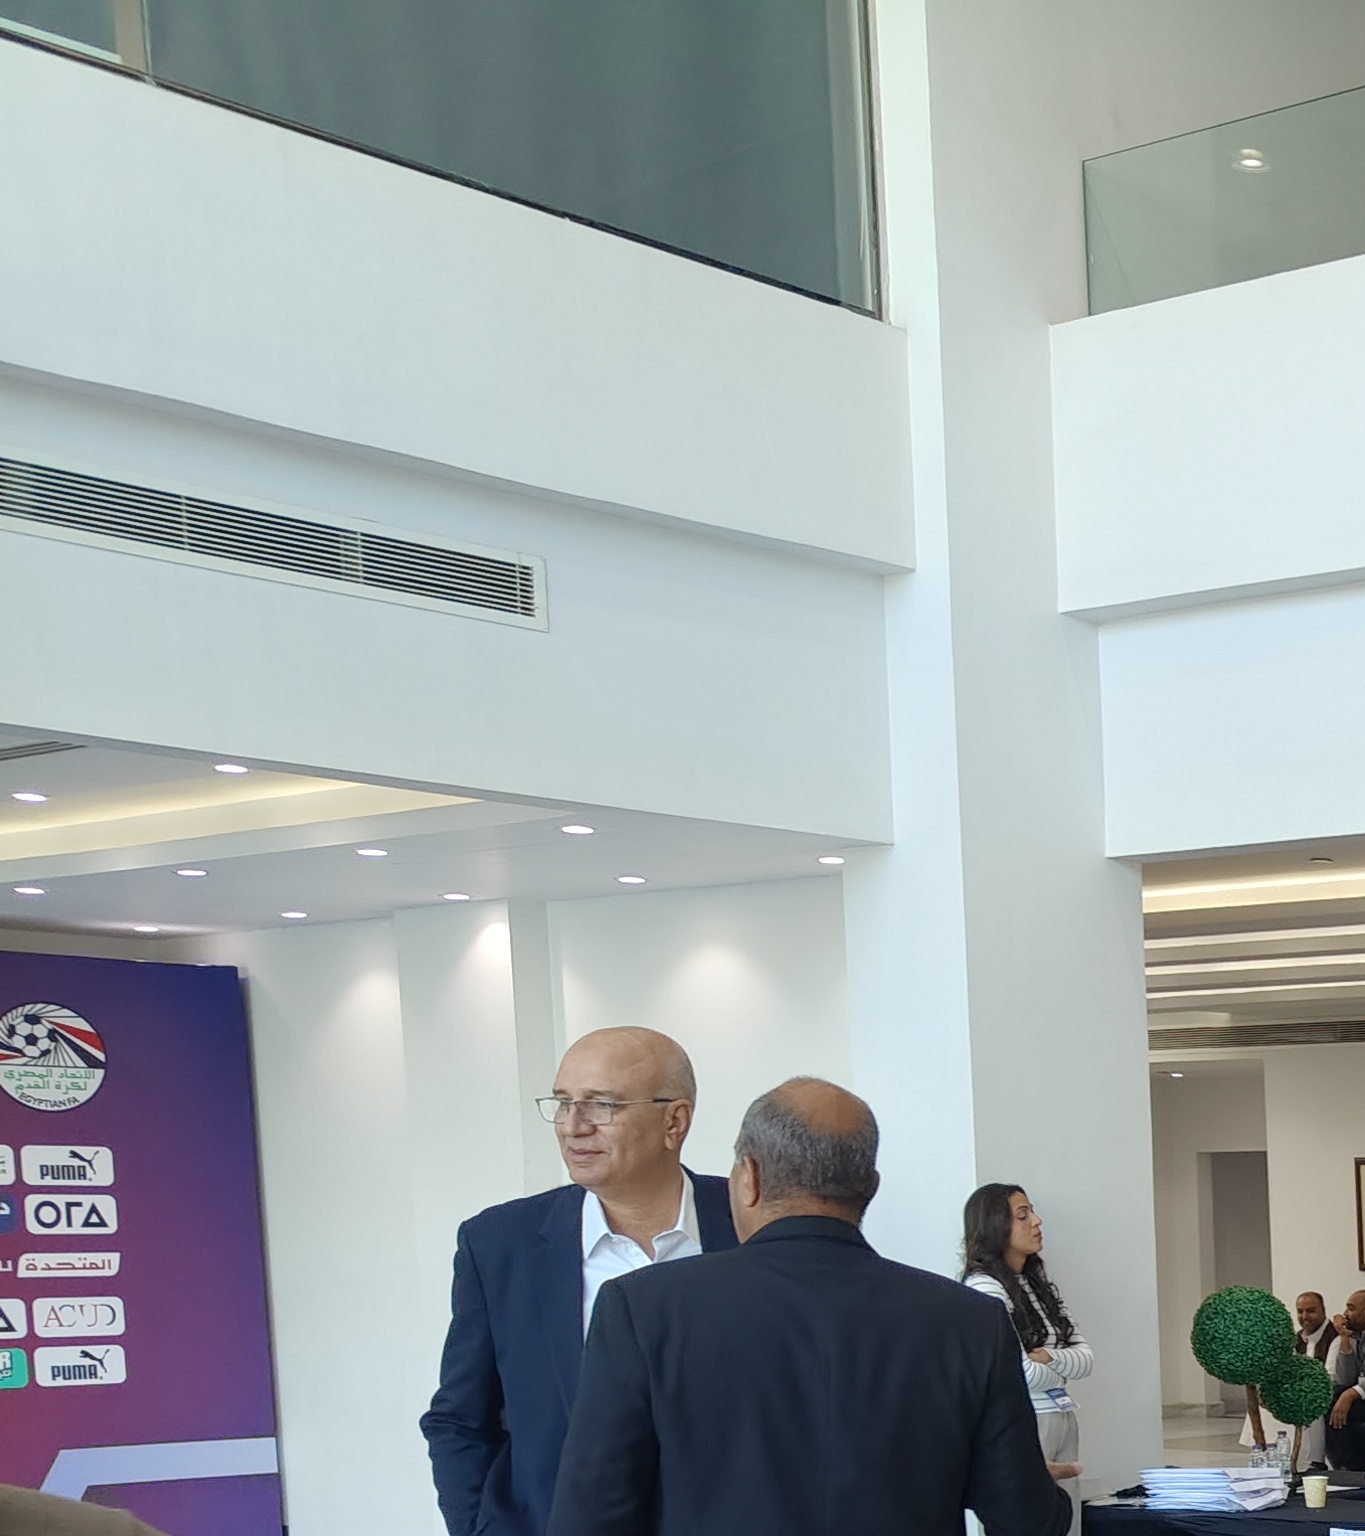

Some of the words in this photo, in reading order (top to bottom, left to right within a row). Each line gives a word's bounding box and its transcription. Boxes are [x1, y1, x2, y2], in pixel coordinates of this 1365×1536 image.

[58, 1069, 95, 1080] الاتحاد
[15, 1079, 50, 1094] القدم
[54, 1081, 87, 1095] لكرة
[39, 1165, 87, 1180] PUMA
[25, 1257, 112, 1271] المتحدة
[42, 1303, 117, 1328] ACUD
[51, 1364, 98, 1381] PUMA
